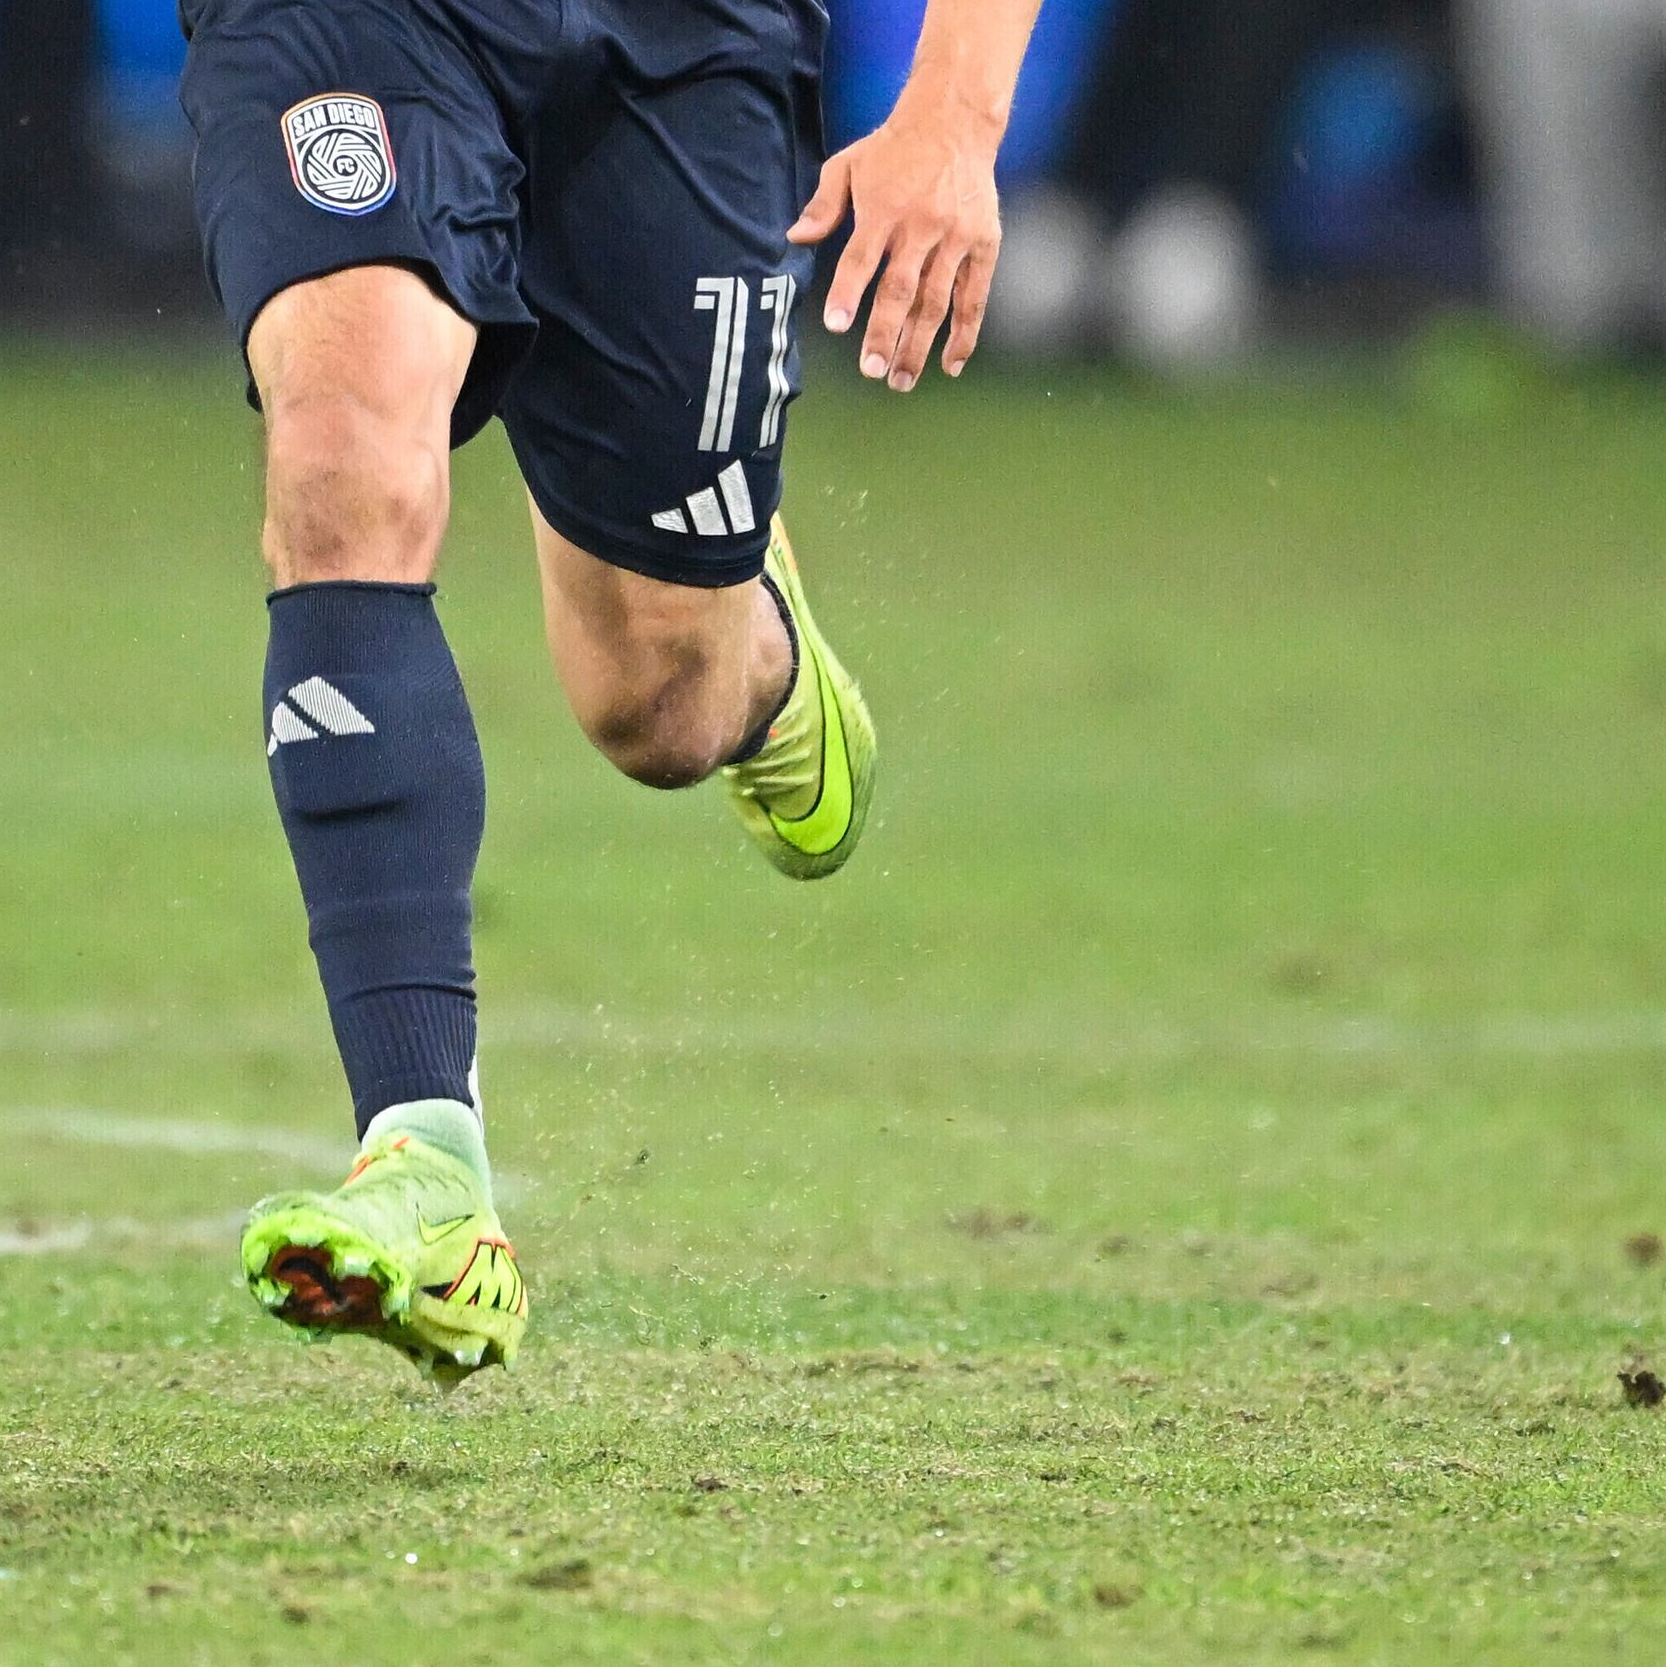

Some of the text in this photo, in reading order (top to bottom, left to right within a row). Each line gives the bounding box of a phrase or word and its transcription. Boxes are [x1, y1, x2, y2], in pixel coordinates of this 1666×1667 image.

[293, 103, 376, 137] SAN DIEGO
[336, 158, 355, 174] FC
[693, 274, 797, 452] 11
